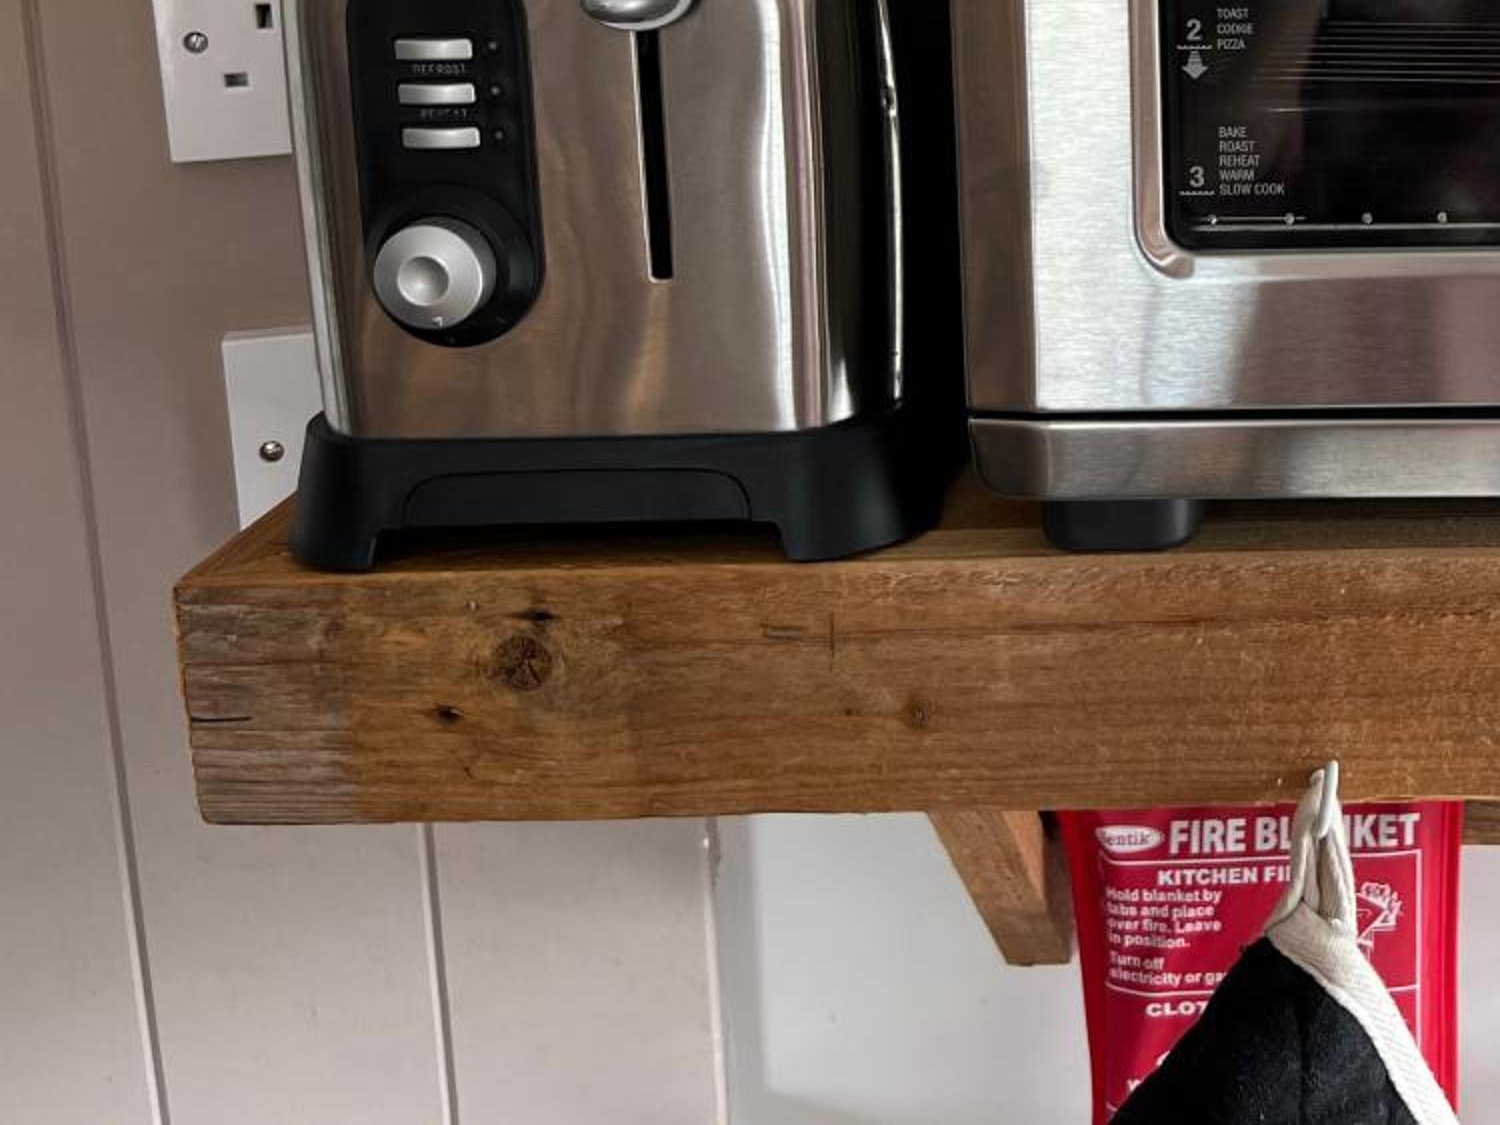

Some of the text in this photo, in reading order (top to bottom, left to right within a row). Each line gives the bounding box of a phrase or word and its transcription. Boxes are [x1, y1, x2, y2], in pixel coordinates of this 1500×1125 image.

[1216, 7, 1249, 20] TOAST
[1186, 18, 1202, 41] 2
[1216, 22, 1254, 34] COOKIE
[1216, 38, 1247, 51] PIZZA
[1219, 125, 1248, 138] BAKE
[1219, 139, 1257, 153] ROAST
[1219, 154, 1261, 167] REHEAT
[1189, 166, 1206, 189] 3
[1219, 168, 1255, 181] WARM
[1219, 181, 1286, 196] SLOW COOK
[1169, 812, 1421, 855] FIRE BLKET
[1157, 865, 1258, 886] KITCHEN
[1105, 886, 1222, 904] Hold blanket by
[1106, 902, 1215, 922] tabs and place
[1106, 917, 1222, 934] over fire. Leave
[1123, 934, 1191, 949] position.
[1110, 951, 1165, 971] Turn off
[1109, 966, 1182, 987] electricity
[1184, 972, 1202, 984] or
